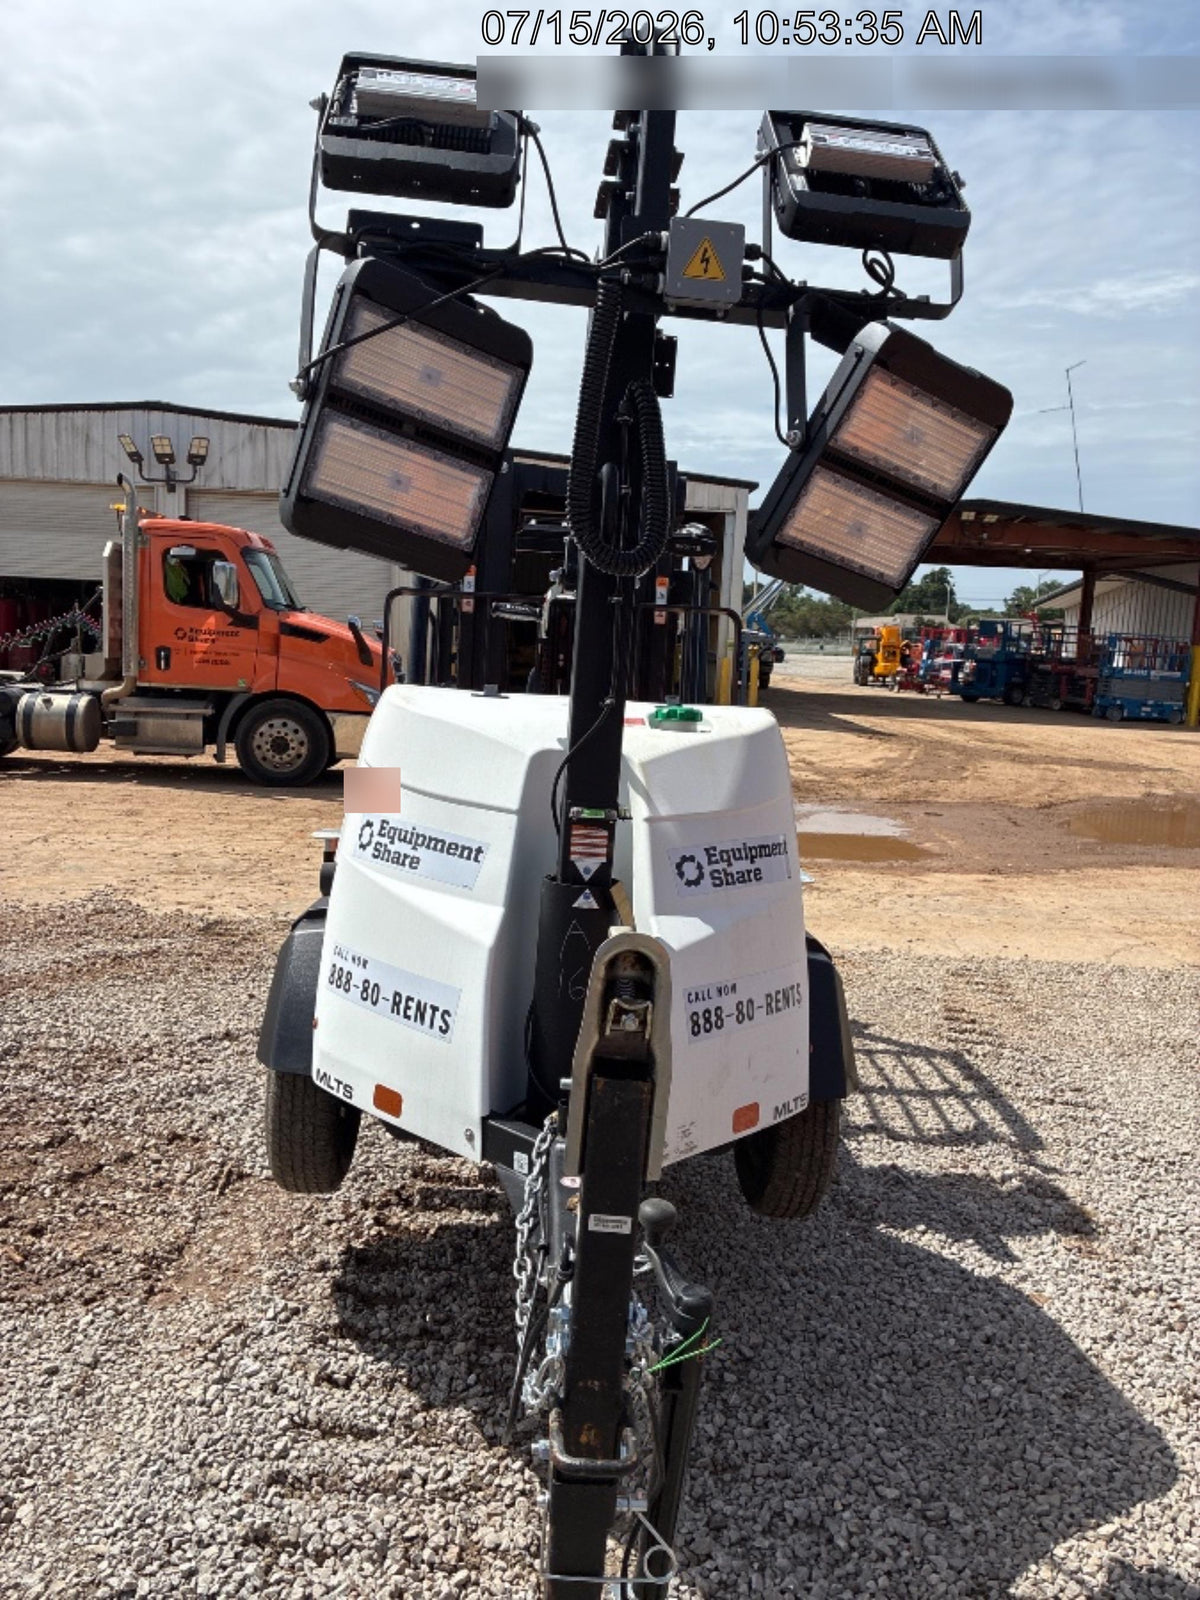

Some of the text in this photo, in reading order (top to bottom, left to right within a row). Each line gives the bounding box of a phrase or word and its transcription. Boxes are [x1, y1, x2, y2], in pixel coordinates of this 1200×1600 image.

[371, 841, 421, 870] Share
[377, 819, 484, 863] Equipment
[703, 839, 788, 868] Equipment
[708, 866, 763, 888] Share
[328, 963, 452, 1035] 888-80-RENTS
[687, 987, 713, 1004] CALL
[689, 982, 803, 1037] 888-80-RENTS
[316, 1067, 354, 1101] MLTS
